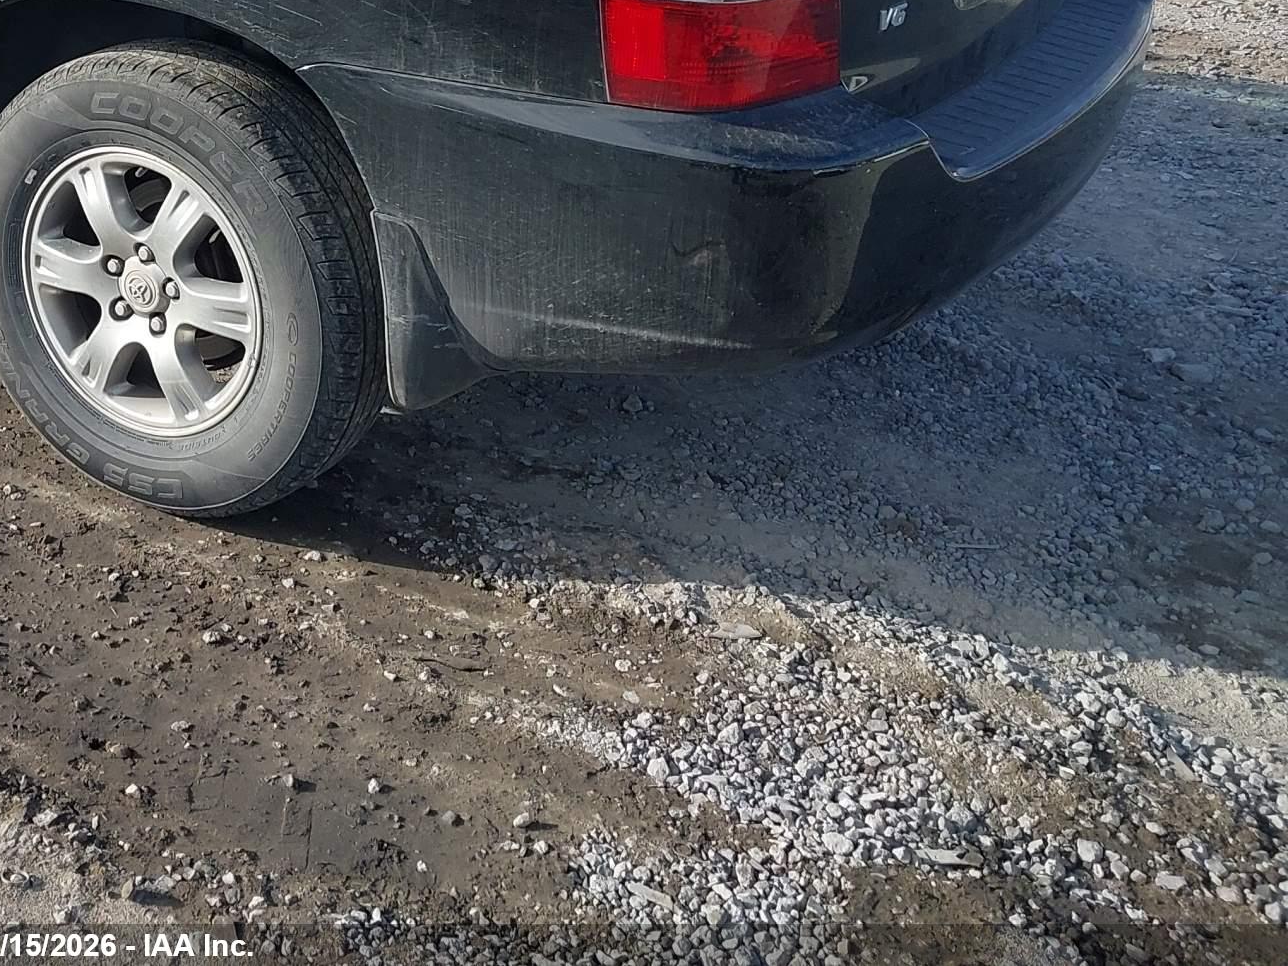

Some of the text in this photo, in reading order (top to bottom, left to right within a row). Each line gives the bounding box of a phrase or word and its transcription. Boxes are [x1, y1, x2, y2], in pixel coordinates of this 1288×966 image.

[878, 1, 908, 32] V6
[90, 91, 269, 219] COOPER
[103, 462, 184, 499] CS5
